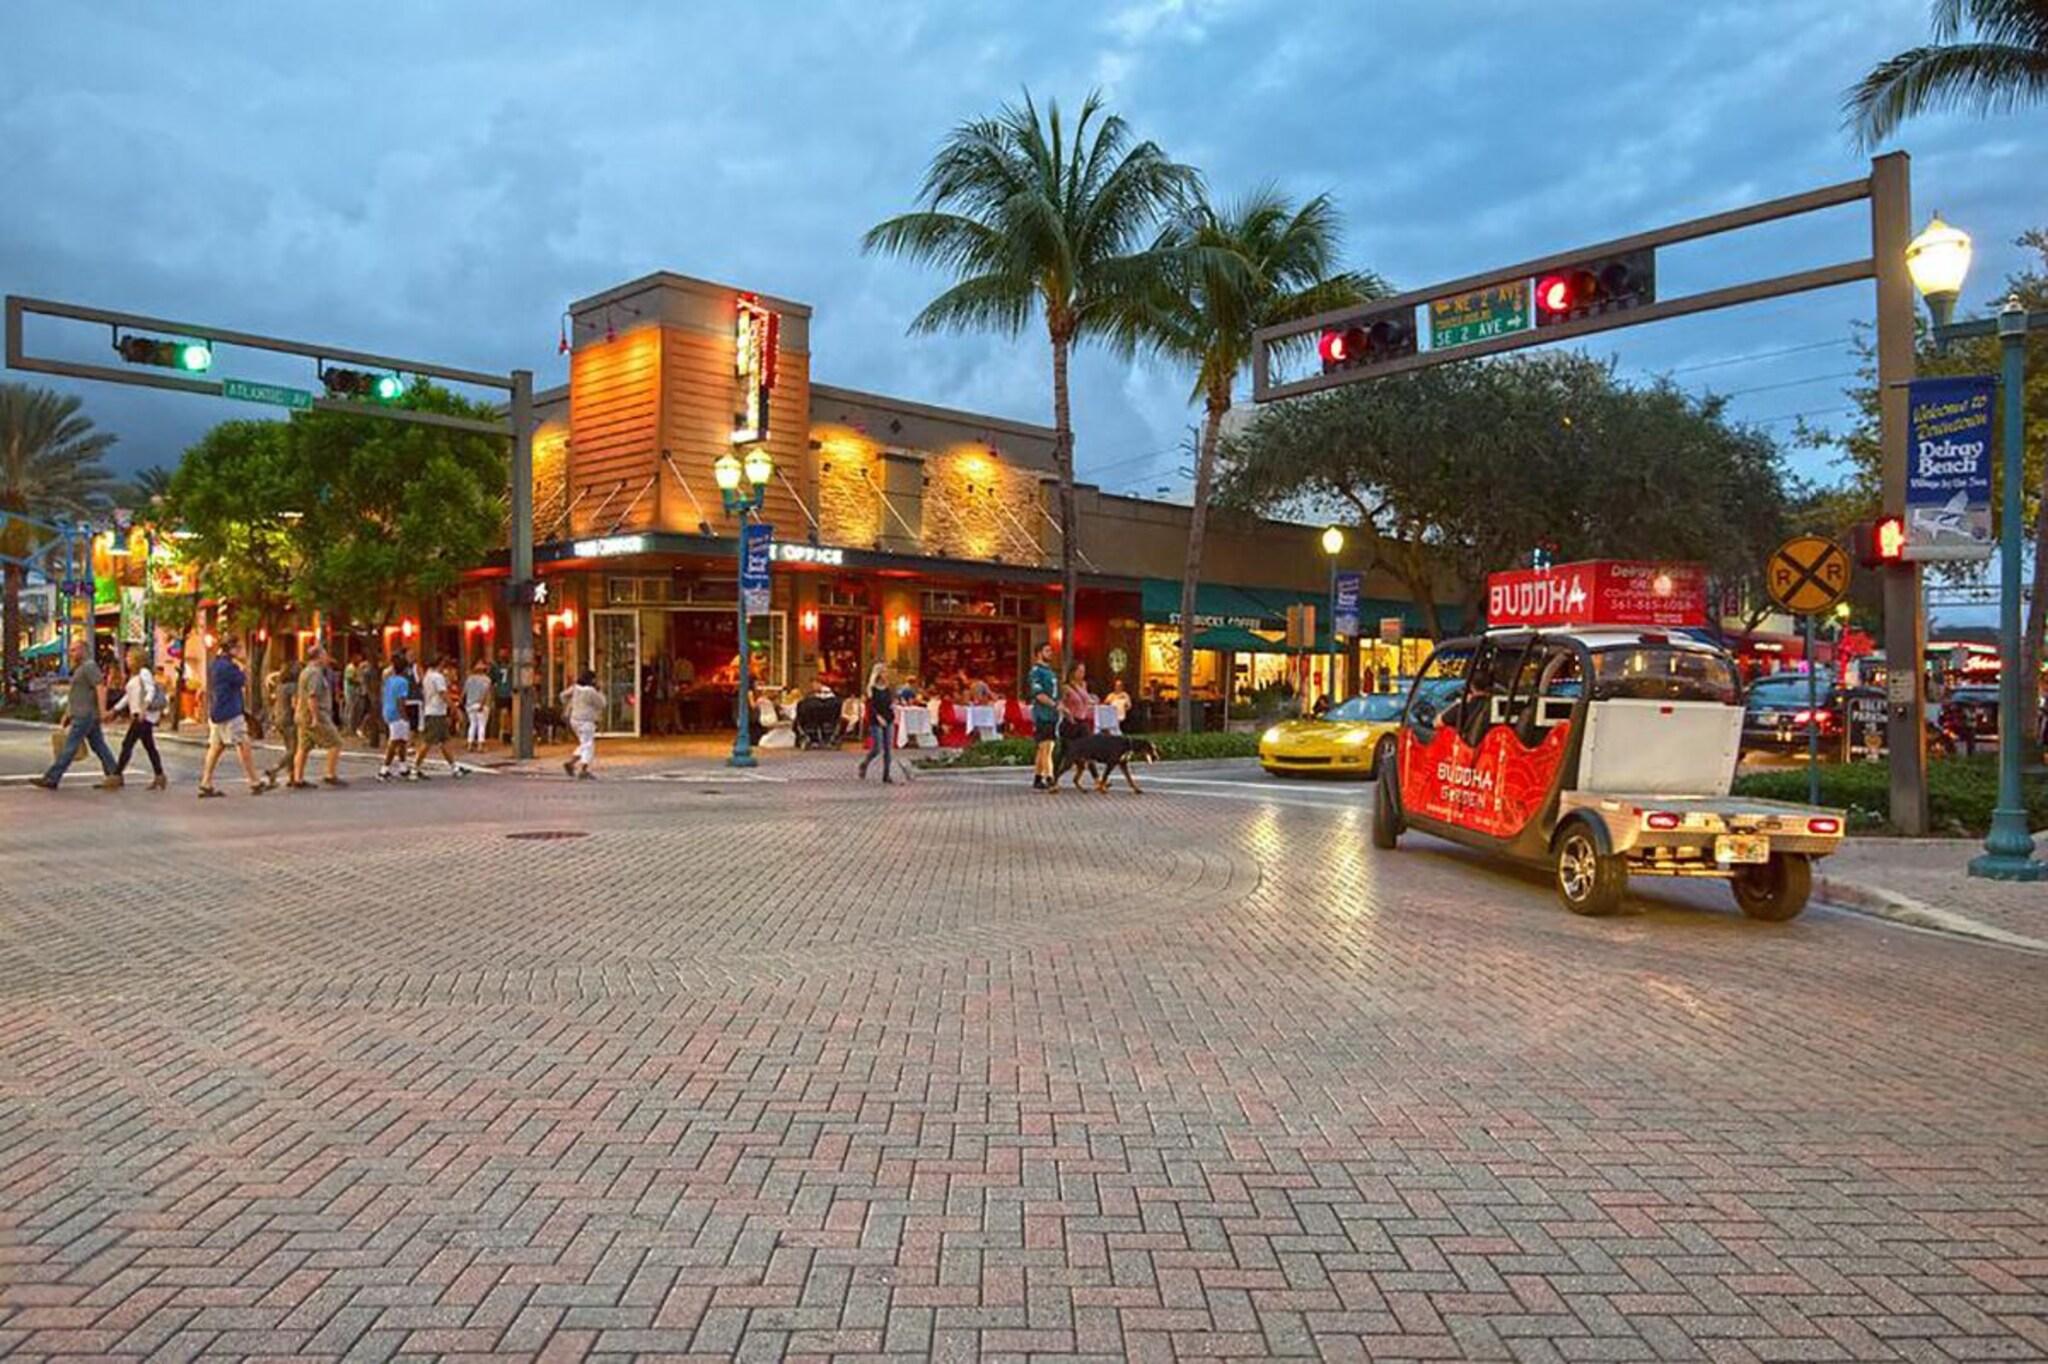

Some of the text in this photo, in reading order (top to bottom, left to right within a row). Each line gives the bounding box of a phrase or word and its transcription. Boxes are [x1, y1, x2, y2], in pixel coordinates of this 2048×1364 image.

[1437, 329, 1452, 346] SE
[1461, 326, 1469, 341] 2
[1478, 318, 1502, 337] AVE
[1919, 440, 1984, 459] Delray
[1919, 457, 1977, 477] Beach
[1776, 564, 1842, 586] R R
[1491, 574, 1587, 616] BUDDHA
[1437, 762, 1493, 791] BUDDHA
